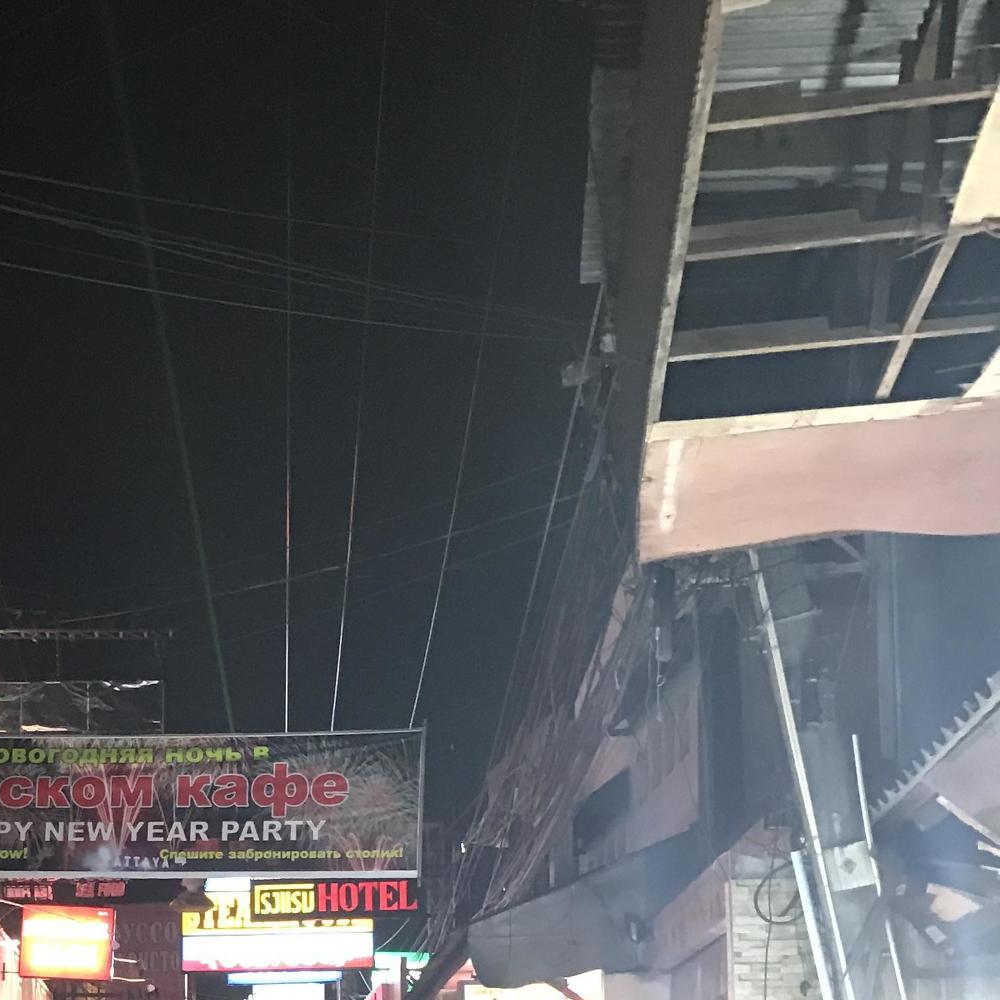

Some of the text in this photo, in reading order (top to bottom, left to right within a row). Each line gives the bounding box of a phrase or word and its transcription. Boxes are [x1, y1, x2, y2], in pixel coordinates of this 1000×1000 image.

[166, 746, 242, 763] ночь
[176, 761, 350, 818] кафе
[44, 821, 115, 842] NEW
[126, 820, 208, 842] YEAR
[220, 819, 327, 841] PARTY
[104, 855, 169, 868] ATTAYA
[159, 847, 404, 861] Спешите забронировать столик!
[317, 880, 418, 912] HOTEL
